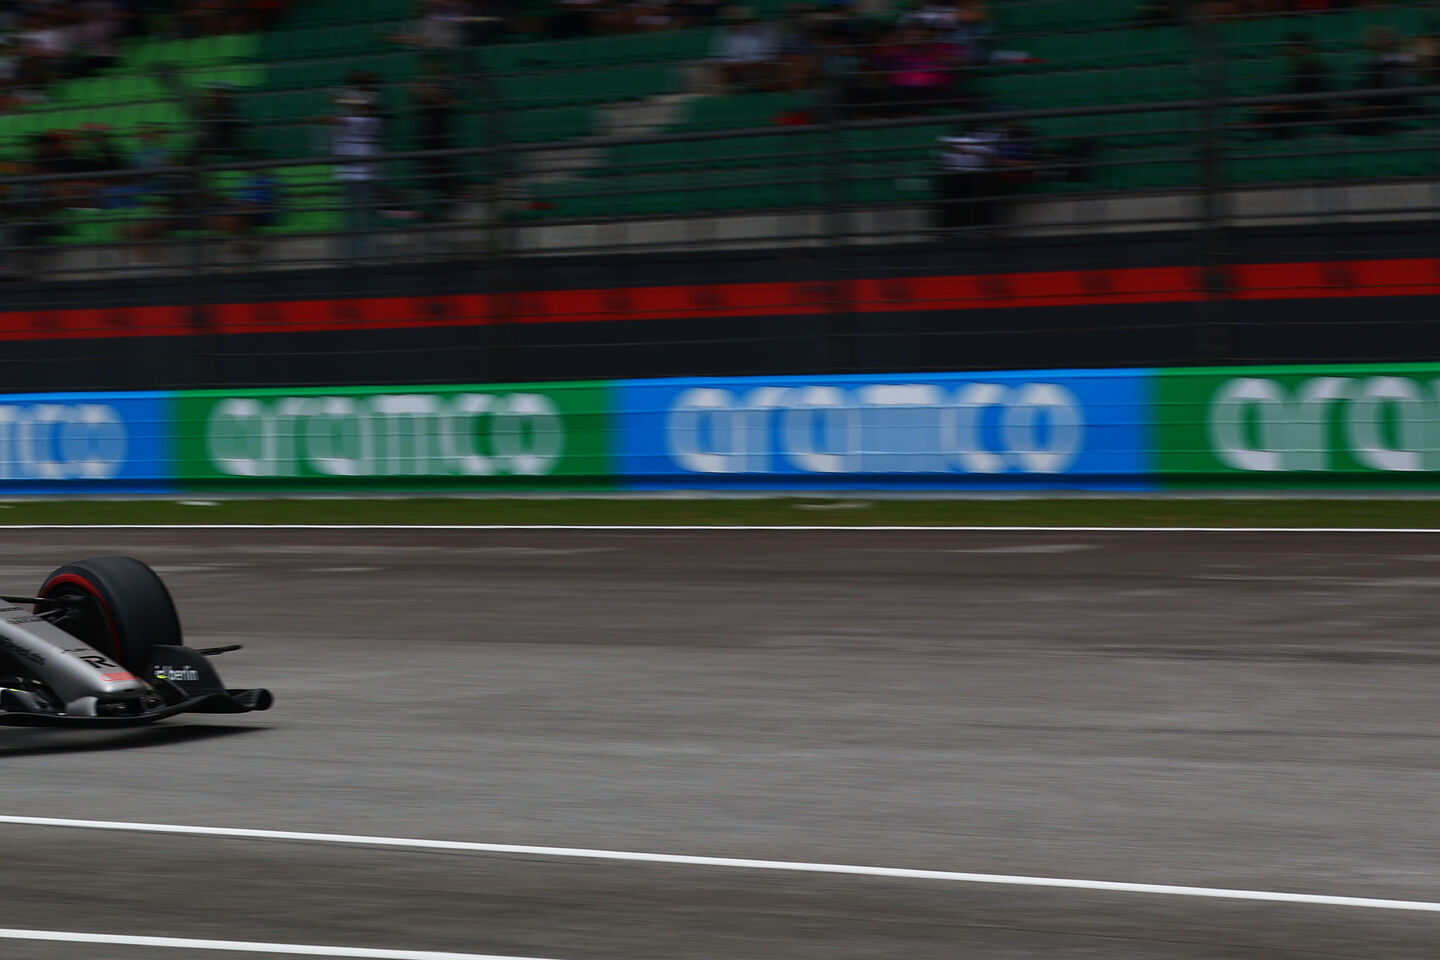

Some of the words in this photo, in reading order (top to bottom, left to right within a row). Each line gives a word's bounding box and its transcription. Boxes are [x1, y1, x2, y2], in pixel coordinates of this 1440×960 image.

[209, 394, 563, 476] aramco
[668, 385, 1082, 473] aramco
[1210, 376, 1440, 470] ara
